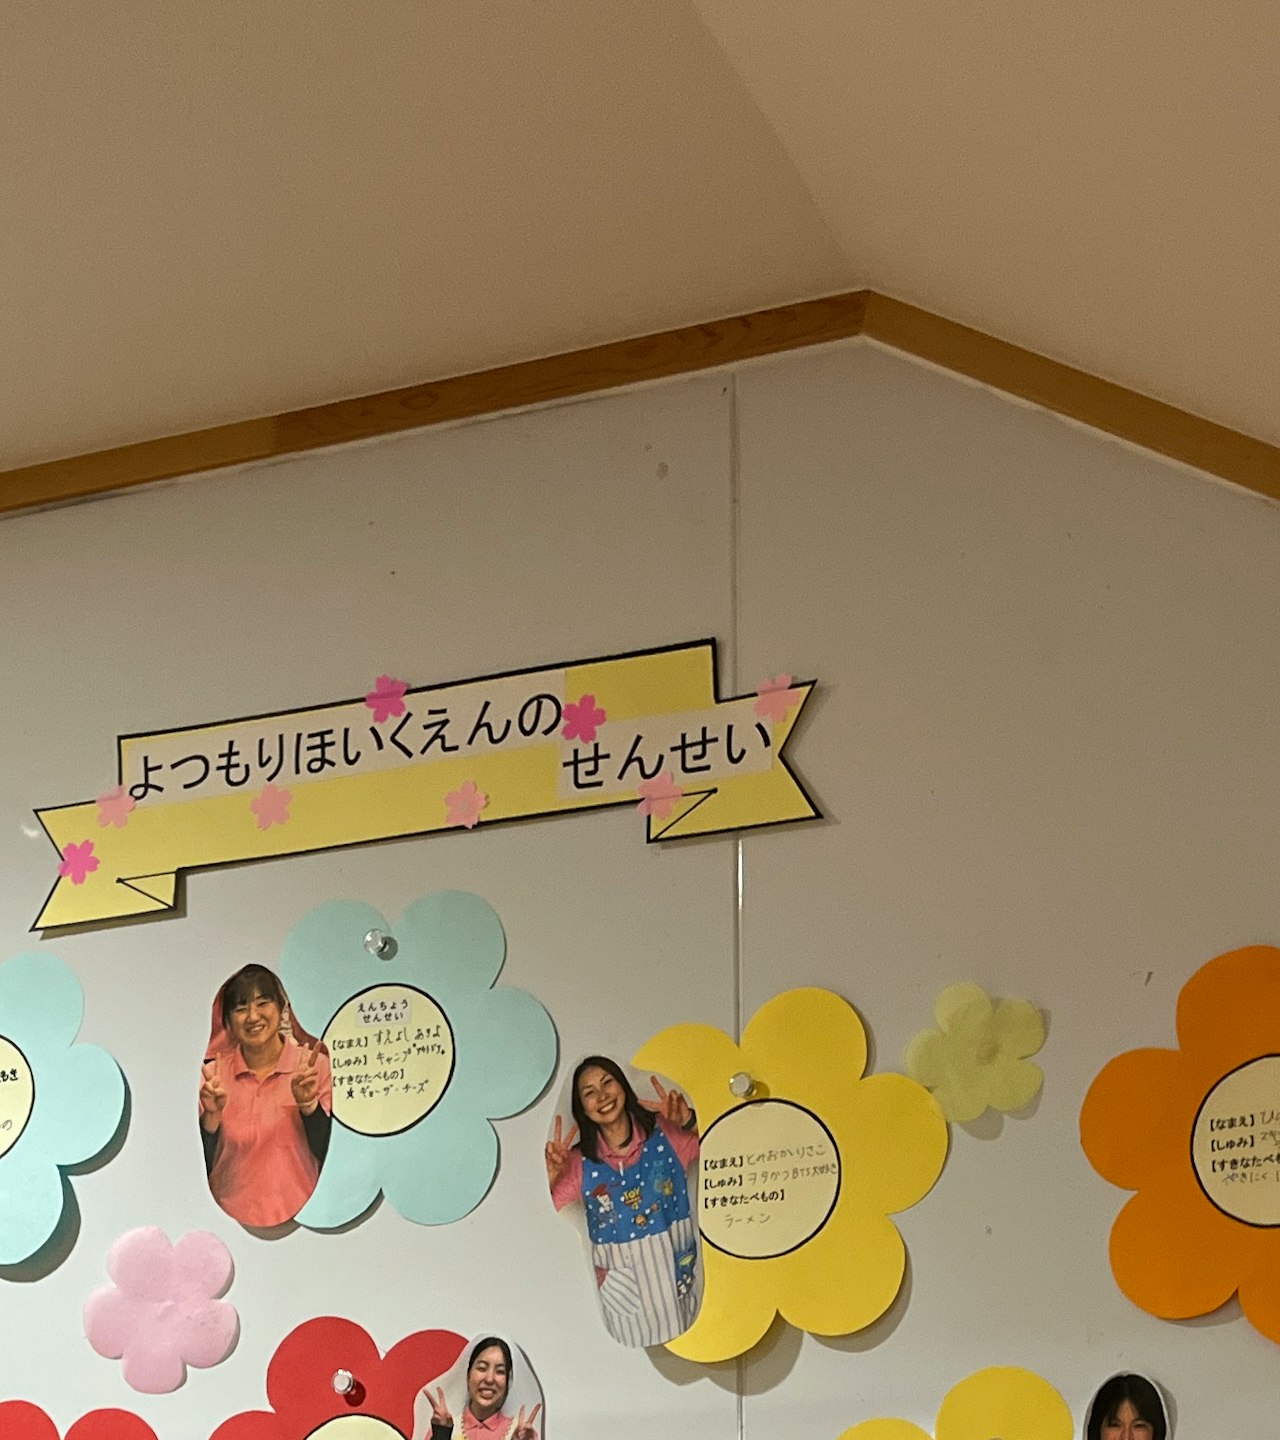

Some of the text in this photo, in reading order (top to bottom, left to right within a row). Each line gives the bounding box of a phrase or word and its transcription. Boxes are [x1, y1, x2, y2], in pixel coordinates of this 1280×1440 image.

[129, 691, 562, 801] よつもりほいくえんの
[562, 719, 771, 790] せんせい
[357, 999, 409, 1014] えんちょう
[363, 1012, 404, 1024] せんせい
[724, 1212, 772, 1229] ラーメン
